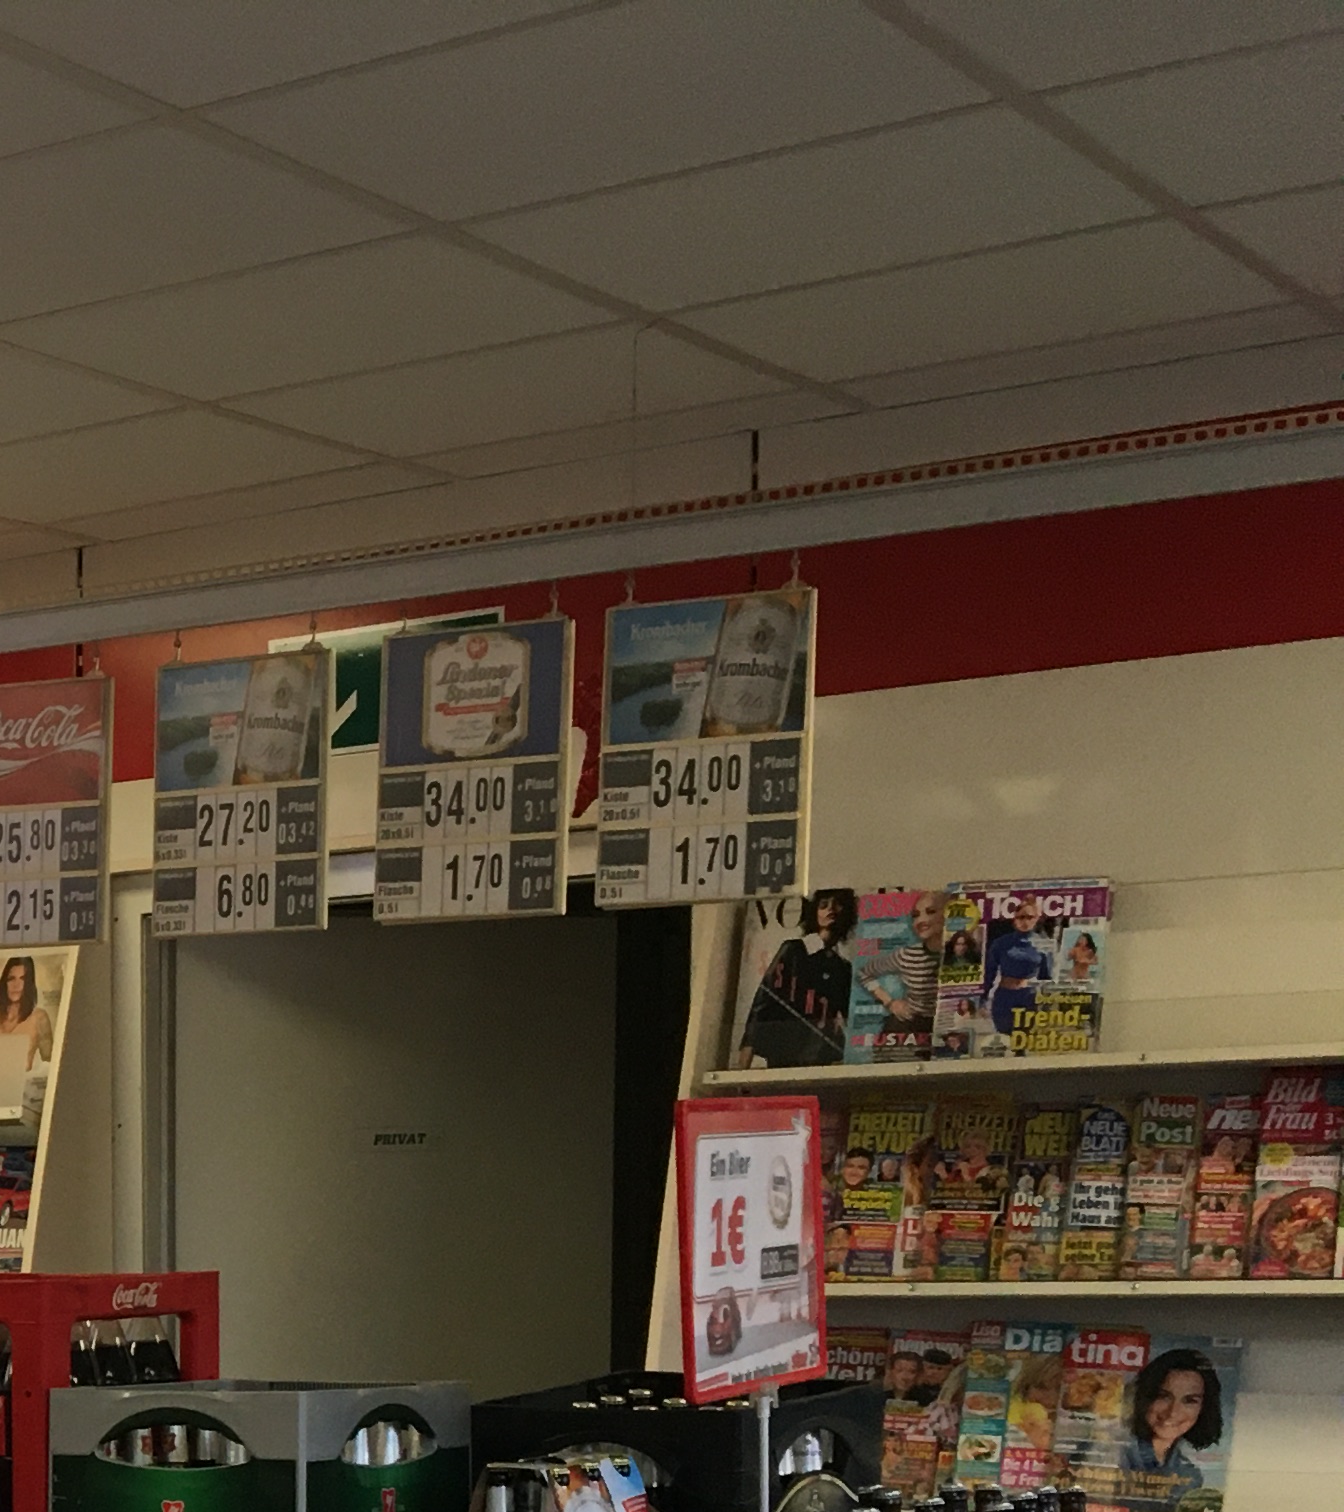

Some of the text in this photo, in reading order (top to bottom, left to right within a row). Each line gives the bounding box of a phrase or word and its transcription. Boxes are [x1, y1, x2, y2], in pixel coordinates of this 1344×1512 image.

[675, 833, 739, 885] 1.70
[446, 853, 503, 902] 1.70
[217, 872, 270, 919] 6.80
[7, 888, 55, 932] 2.15
[1013, 1008, 1090, 1028] Trend-
[1012, 1029, 1089, 1052] Diäten
[1267, 1078, 1322, 1103] Bild
[1142, 1097, 1196, 1119] Neue
[1263, 1104, 1319, 1130] Frau
[850, 1112, 926, 1132] FREIZEIT
[1083, 1122, 1127, 1137] NEUE
[1140, 1121, 1193, 1144] Post
[373, 1133, 427, 1146] PRIVAT
[112, 1282, 161, 1309] Coca-Cola
[1070, 1333, 1145, 1367] tina
